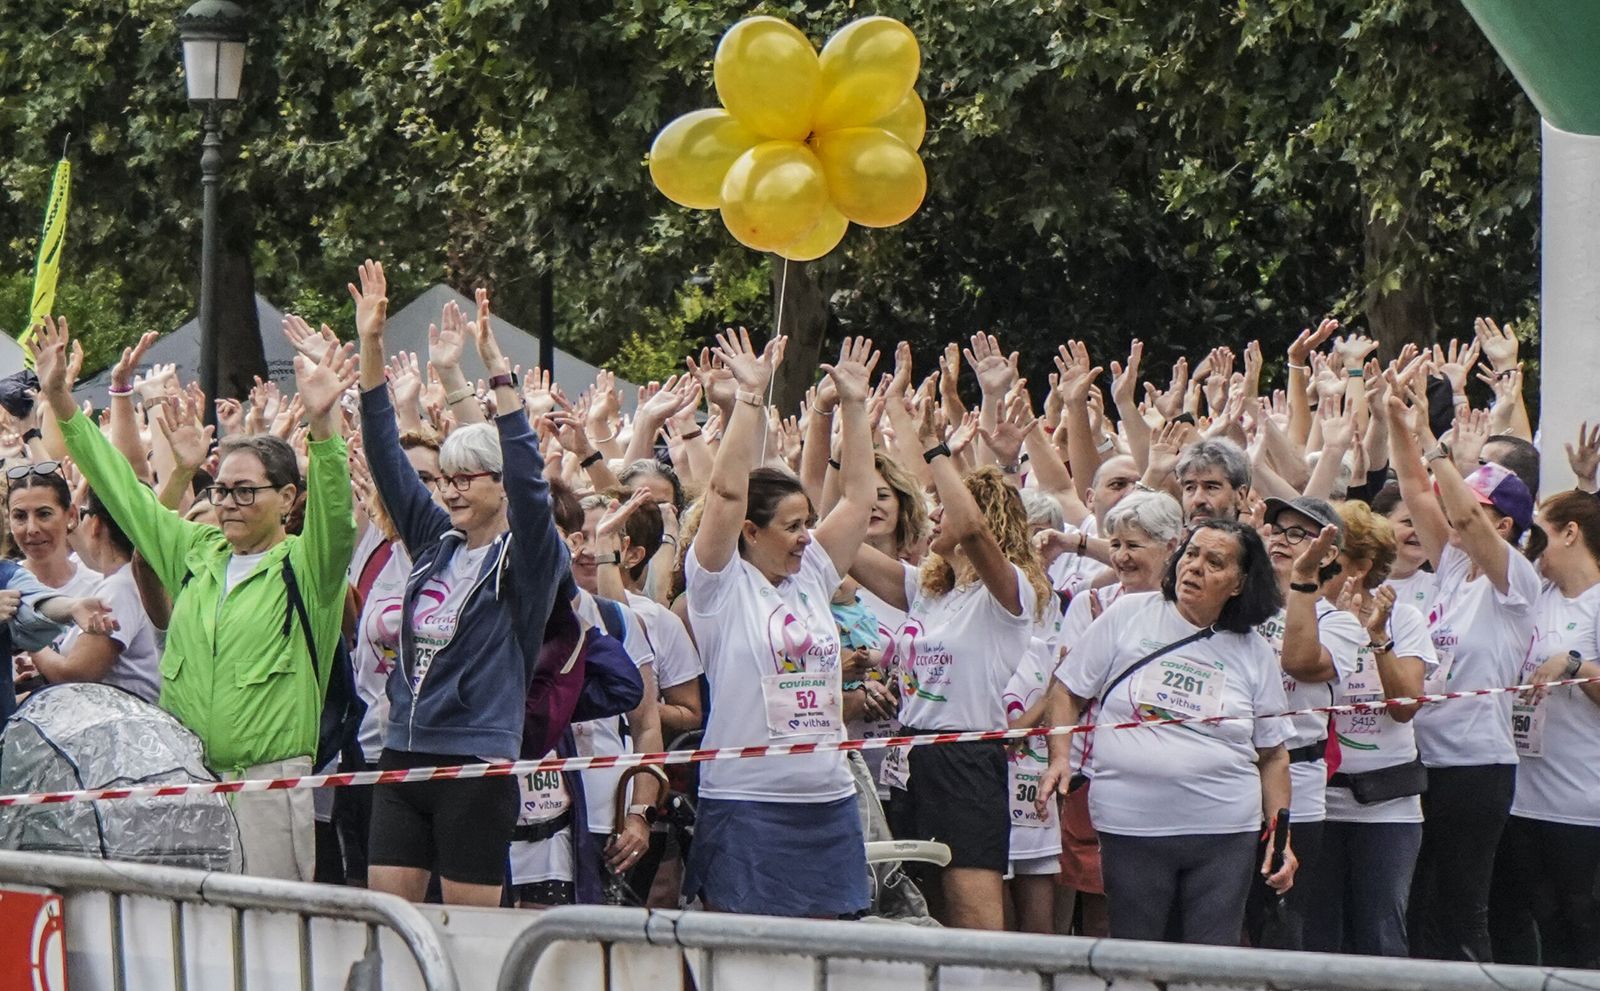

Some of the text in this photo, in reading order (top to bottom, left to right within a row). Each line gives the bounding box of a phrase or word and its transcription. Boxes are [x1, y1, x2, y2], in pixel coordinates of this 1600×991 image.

[1161, 670, 1204, 695] 2261
[796, 690, 818, 709] 52
[1170, 698, 1201, 711] vithas
[803, 718, 831, 728] vithas
[524, 770, 560, 792] 1649
[539, 801, 563, 810] vithas
